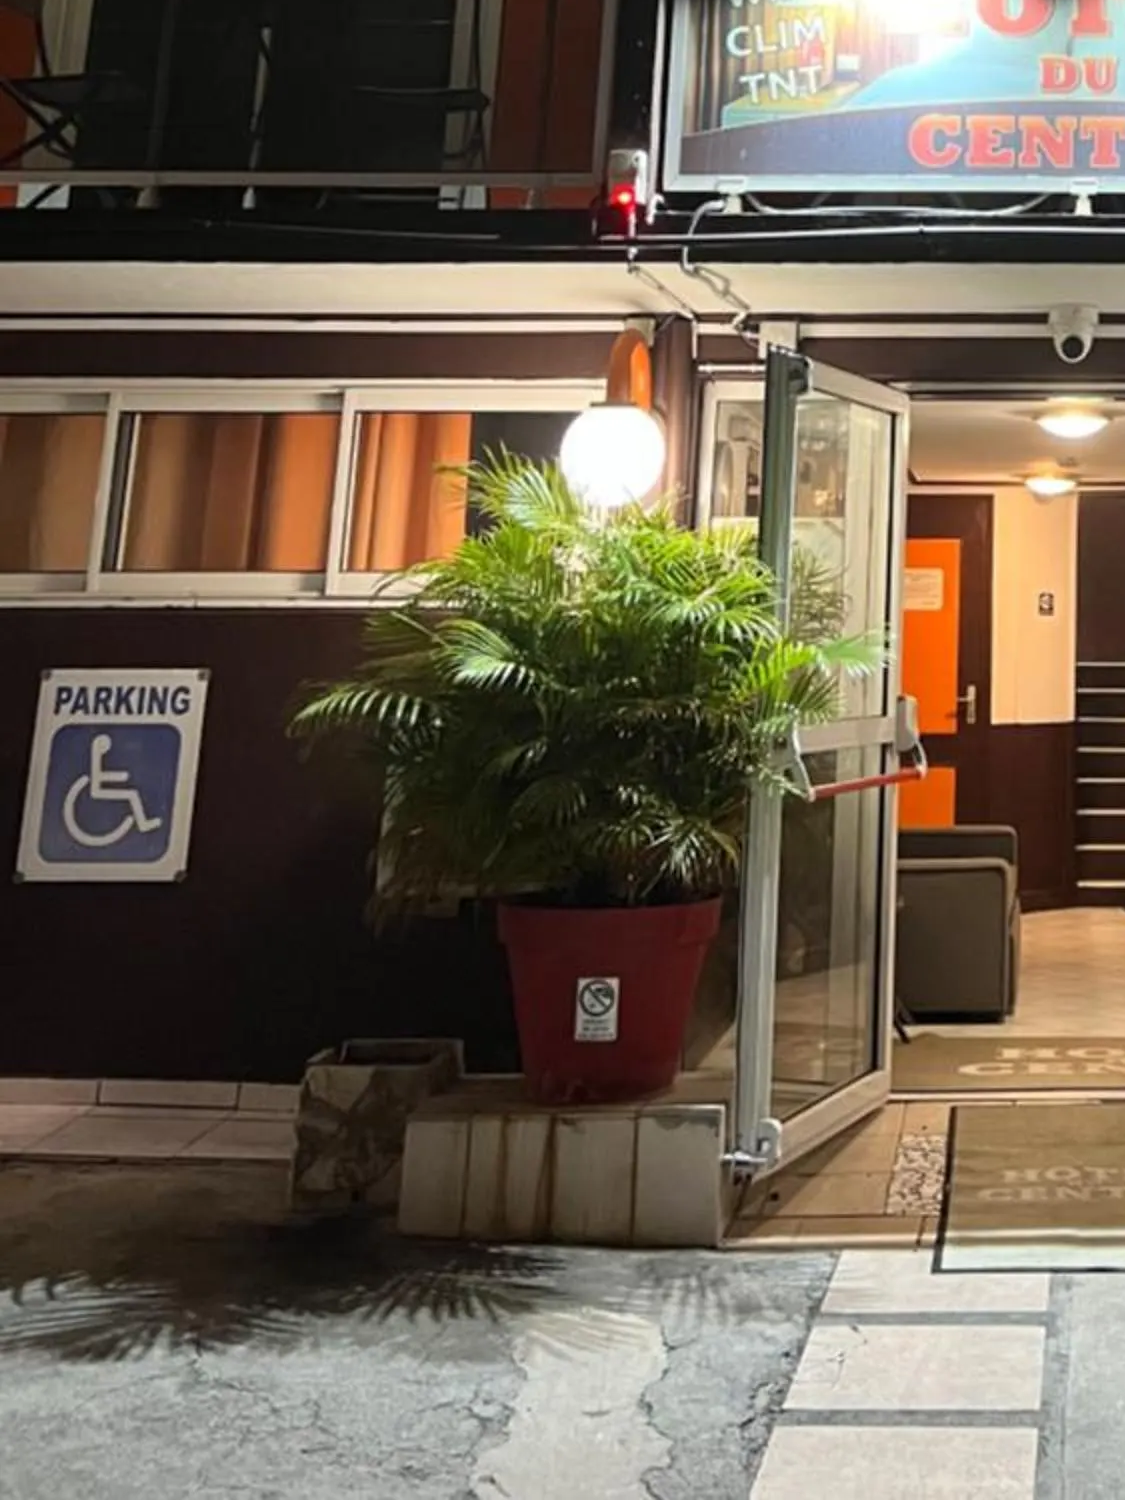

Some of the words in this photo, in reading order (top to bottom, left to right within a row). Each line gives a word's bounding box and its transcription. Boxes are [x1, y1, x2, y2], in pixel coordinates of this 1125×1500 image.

[725, 16, 825, 57] CLIM
[739, 64, 823, 104] TNT
[1039, 55, 1118, 94] DU
[53, 686, 192, 716] PARKING
